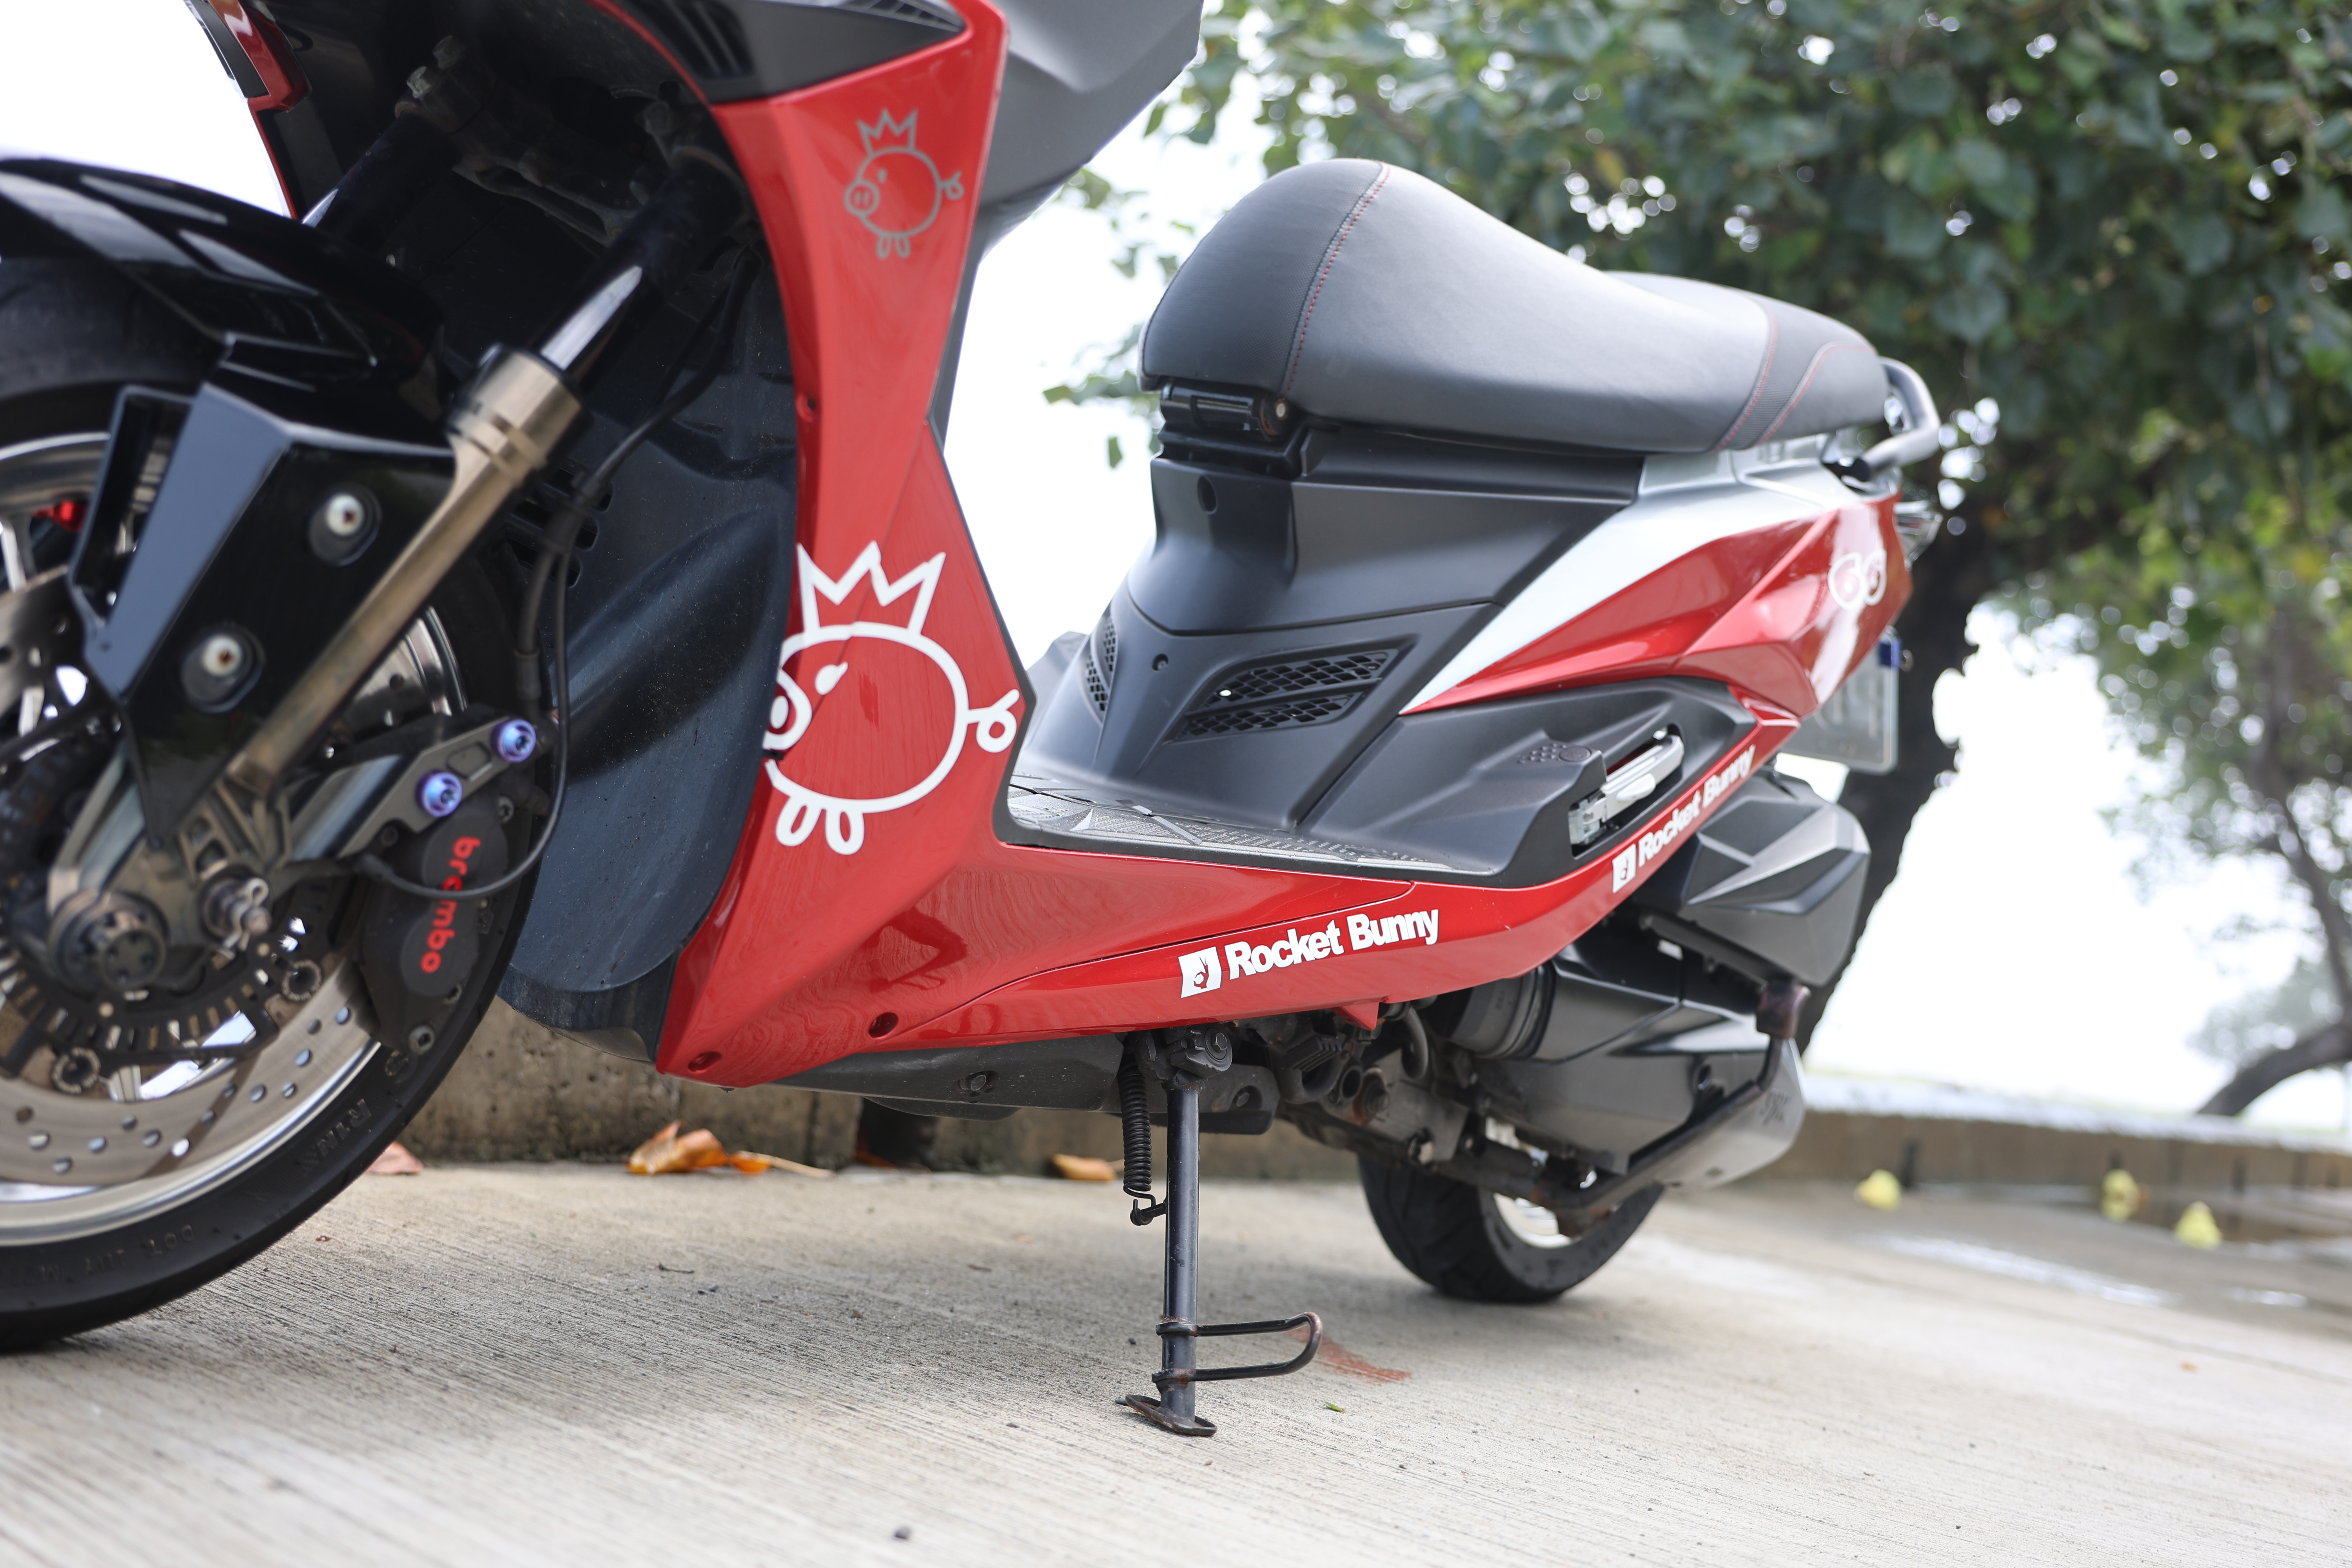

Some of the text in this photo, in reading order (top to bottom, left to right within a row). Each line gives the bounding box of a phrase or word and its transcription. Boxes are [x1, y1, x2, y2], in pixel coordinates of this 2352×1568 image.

[1638, 744, 1756, 867] Rocket Bunny
[1224, 909, 1439, 980] Rocket Bunny
